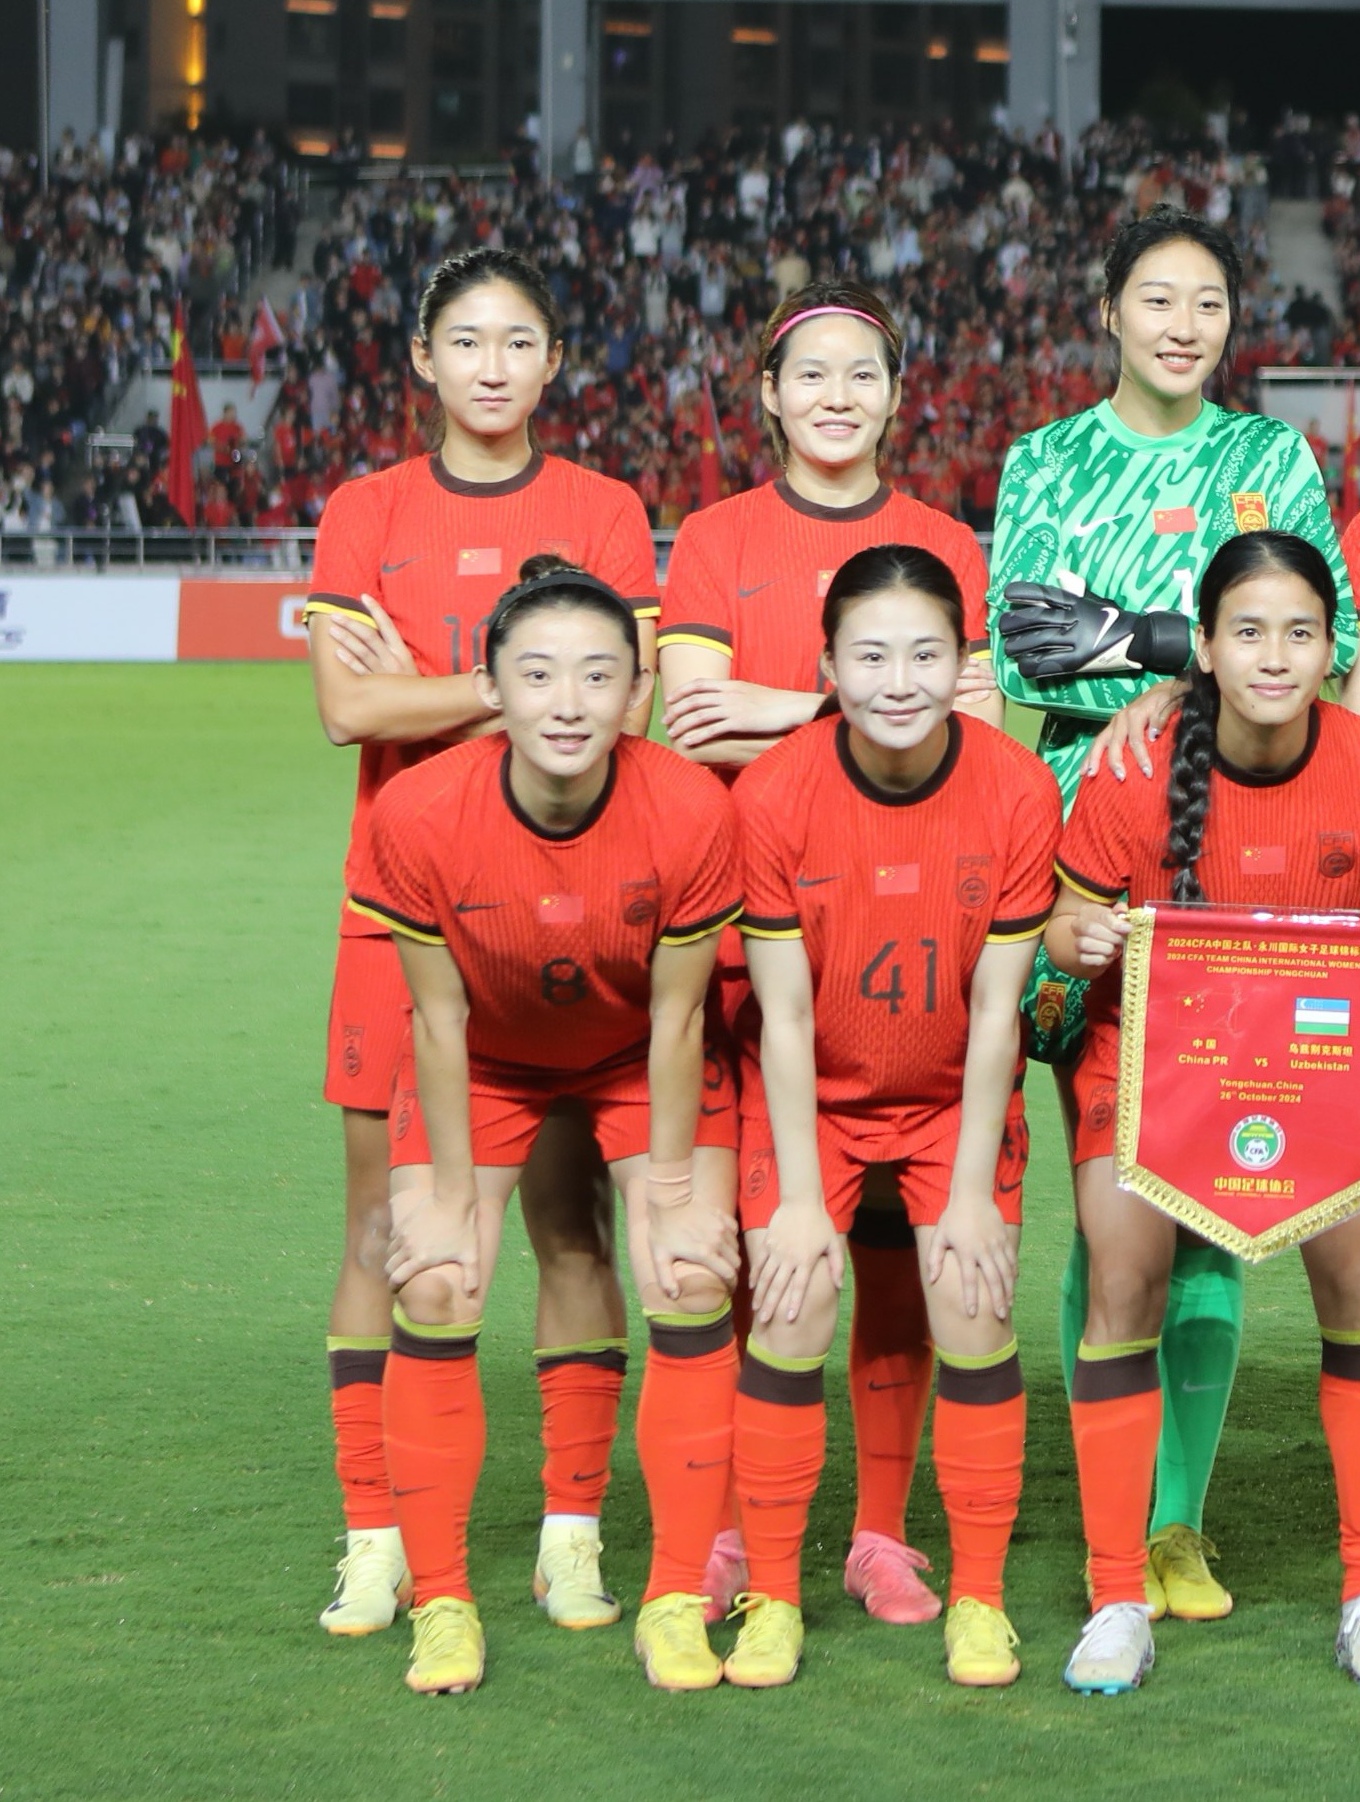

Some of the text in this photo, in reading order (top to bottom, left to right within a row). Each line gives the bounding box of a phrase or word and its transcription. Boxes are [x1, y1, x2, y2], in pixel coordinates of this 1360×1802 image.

[1206, 954, 1230, 962] TEAM
[1230, 956, 1258, 964] CHINA
[1258, 957, 1328, 968] INTERNATIONAL
[860, 938, 938, 1015] 41
[1206, 965, 1329, 979] CHAMPIONSHIP YONGCHUAN
[1178, 1054, 1211, 1066] China
[1212, 1055, 1229, 1067] PR
[1290, 1060, 1350, 1072] Uzbekistan
[1238, 1091, 1277, 1102] October
[1279, 1093, 1302, 1104] 2024
